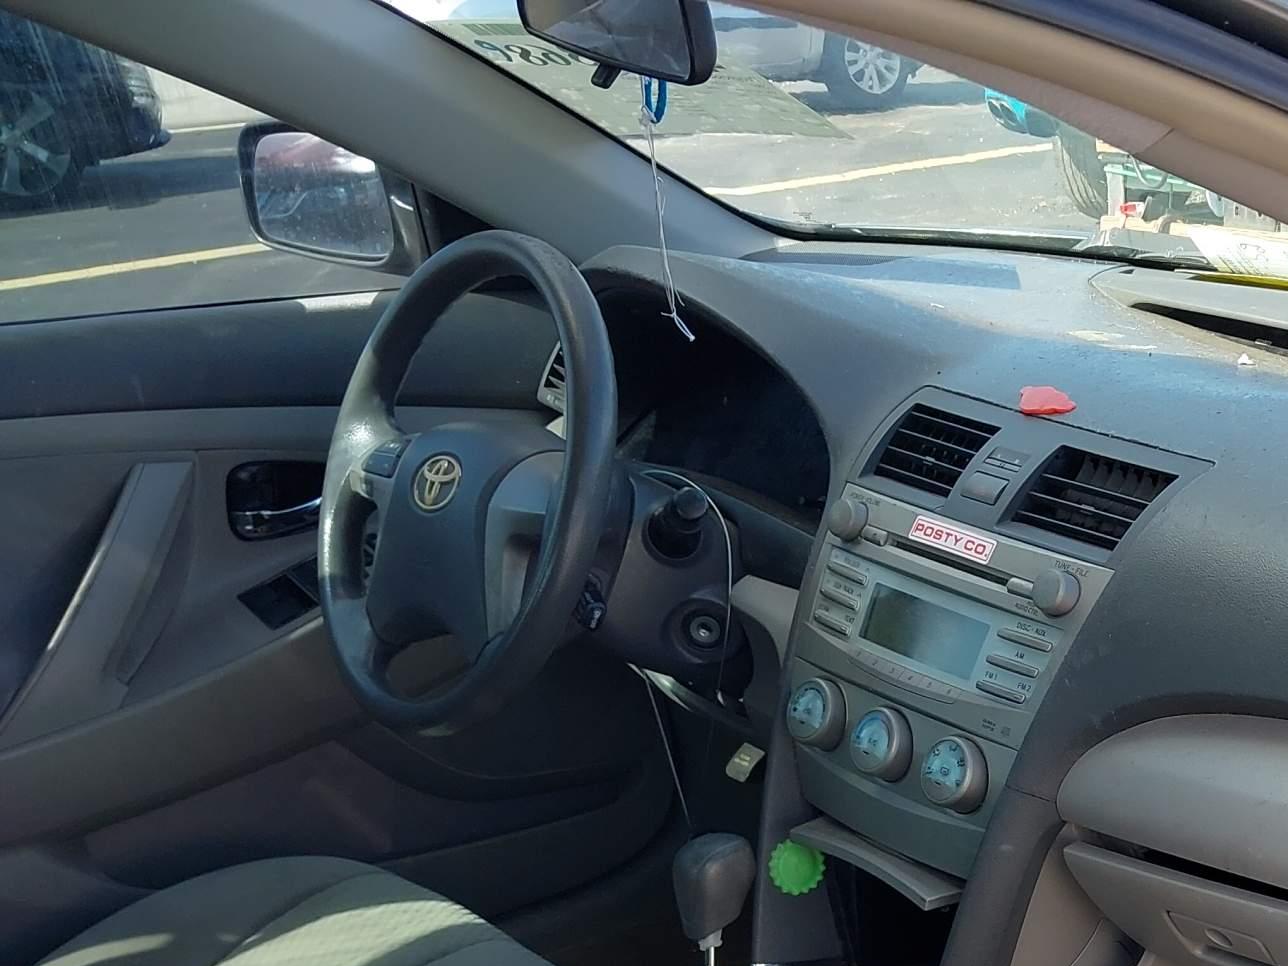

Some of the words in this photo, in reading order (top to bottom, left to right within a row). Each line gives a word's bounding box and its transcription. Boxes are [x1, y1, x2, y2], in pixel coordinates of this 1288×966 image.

[914, 522, 963, 547] POSTY
[963, 540, 989, 558] CO.
[1015, 650, 1025, 660] AM
